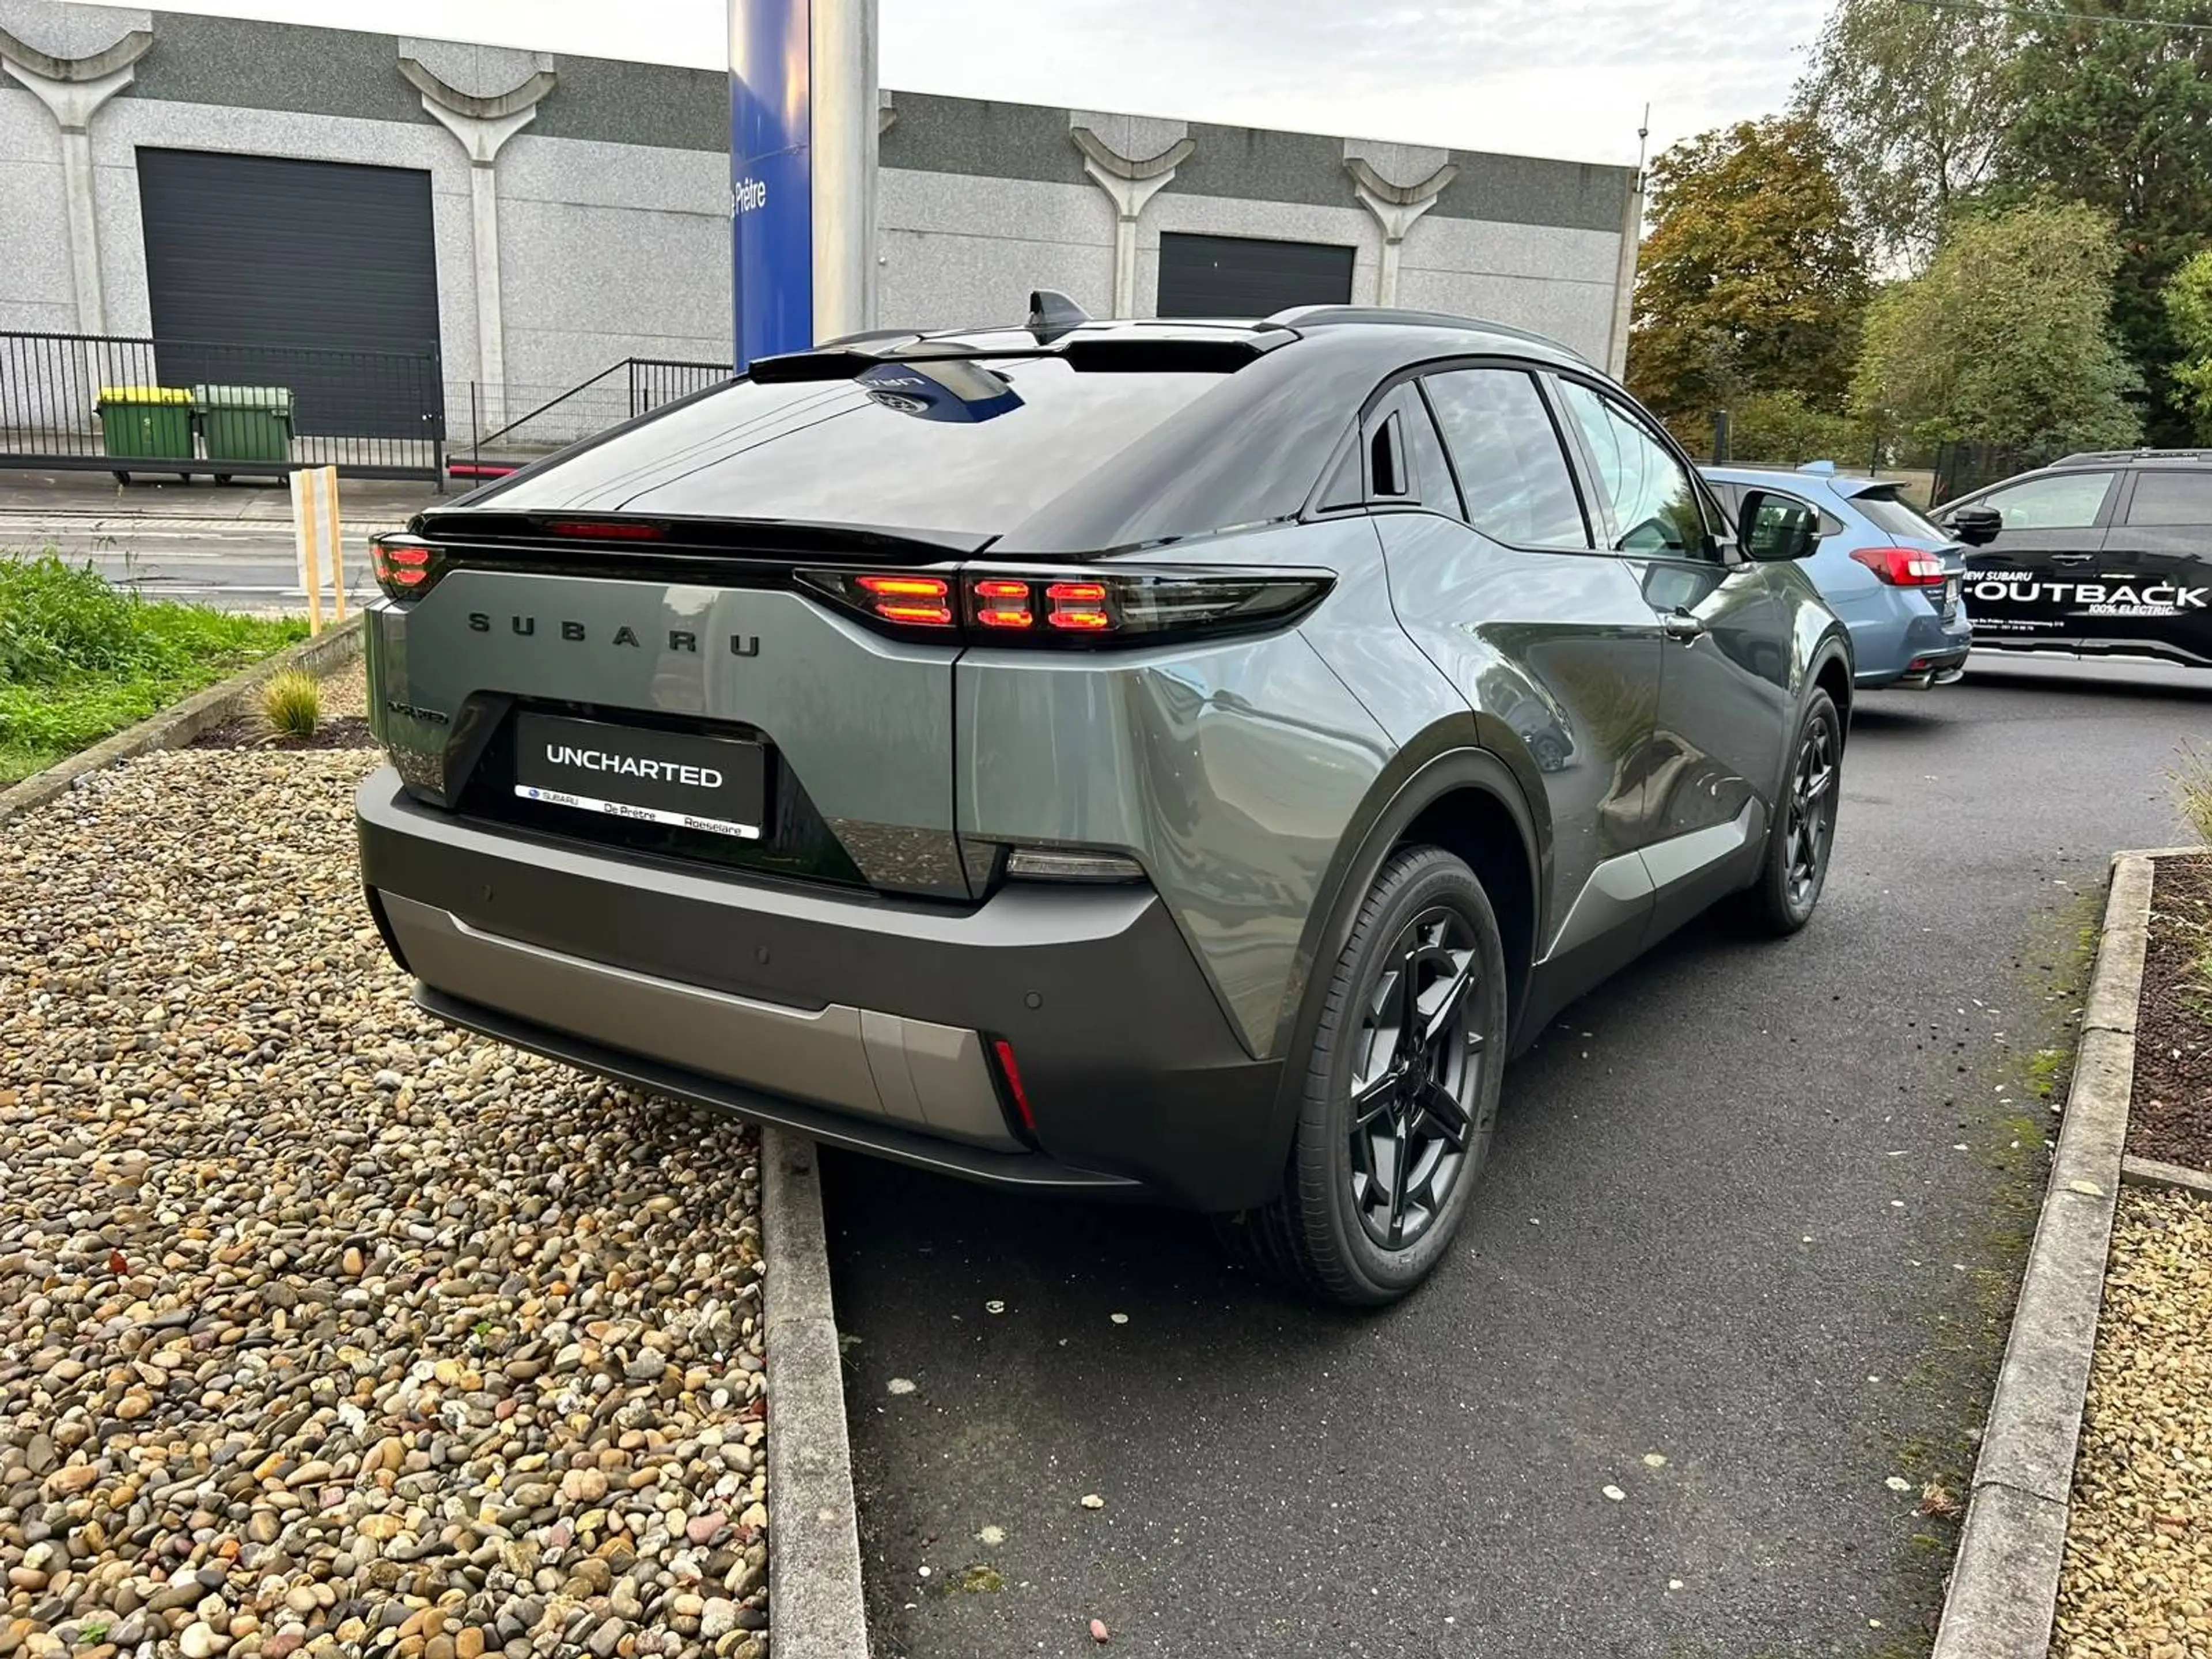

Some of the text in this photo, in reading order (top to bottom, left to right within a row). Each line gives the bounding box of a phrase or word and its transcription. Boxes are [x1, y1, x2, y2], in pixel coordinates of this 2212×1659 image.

[735, 177, 766, 215] Prêtre
[1986, 571, 2033, 581] SUBARU
[2089, 604, 2175, 615] 100% ELECTRIC
[468, 612, 760, 658] SUBARU
[546, 744, 724, 788] UNCHARTED
[542, 791, 579, 806] SUBARU
[604, 803, 619, 814] De
[684, 817, 742, 835] Roeselare
